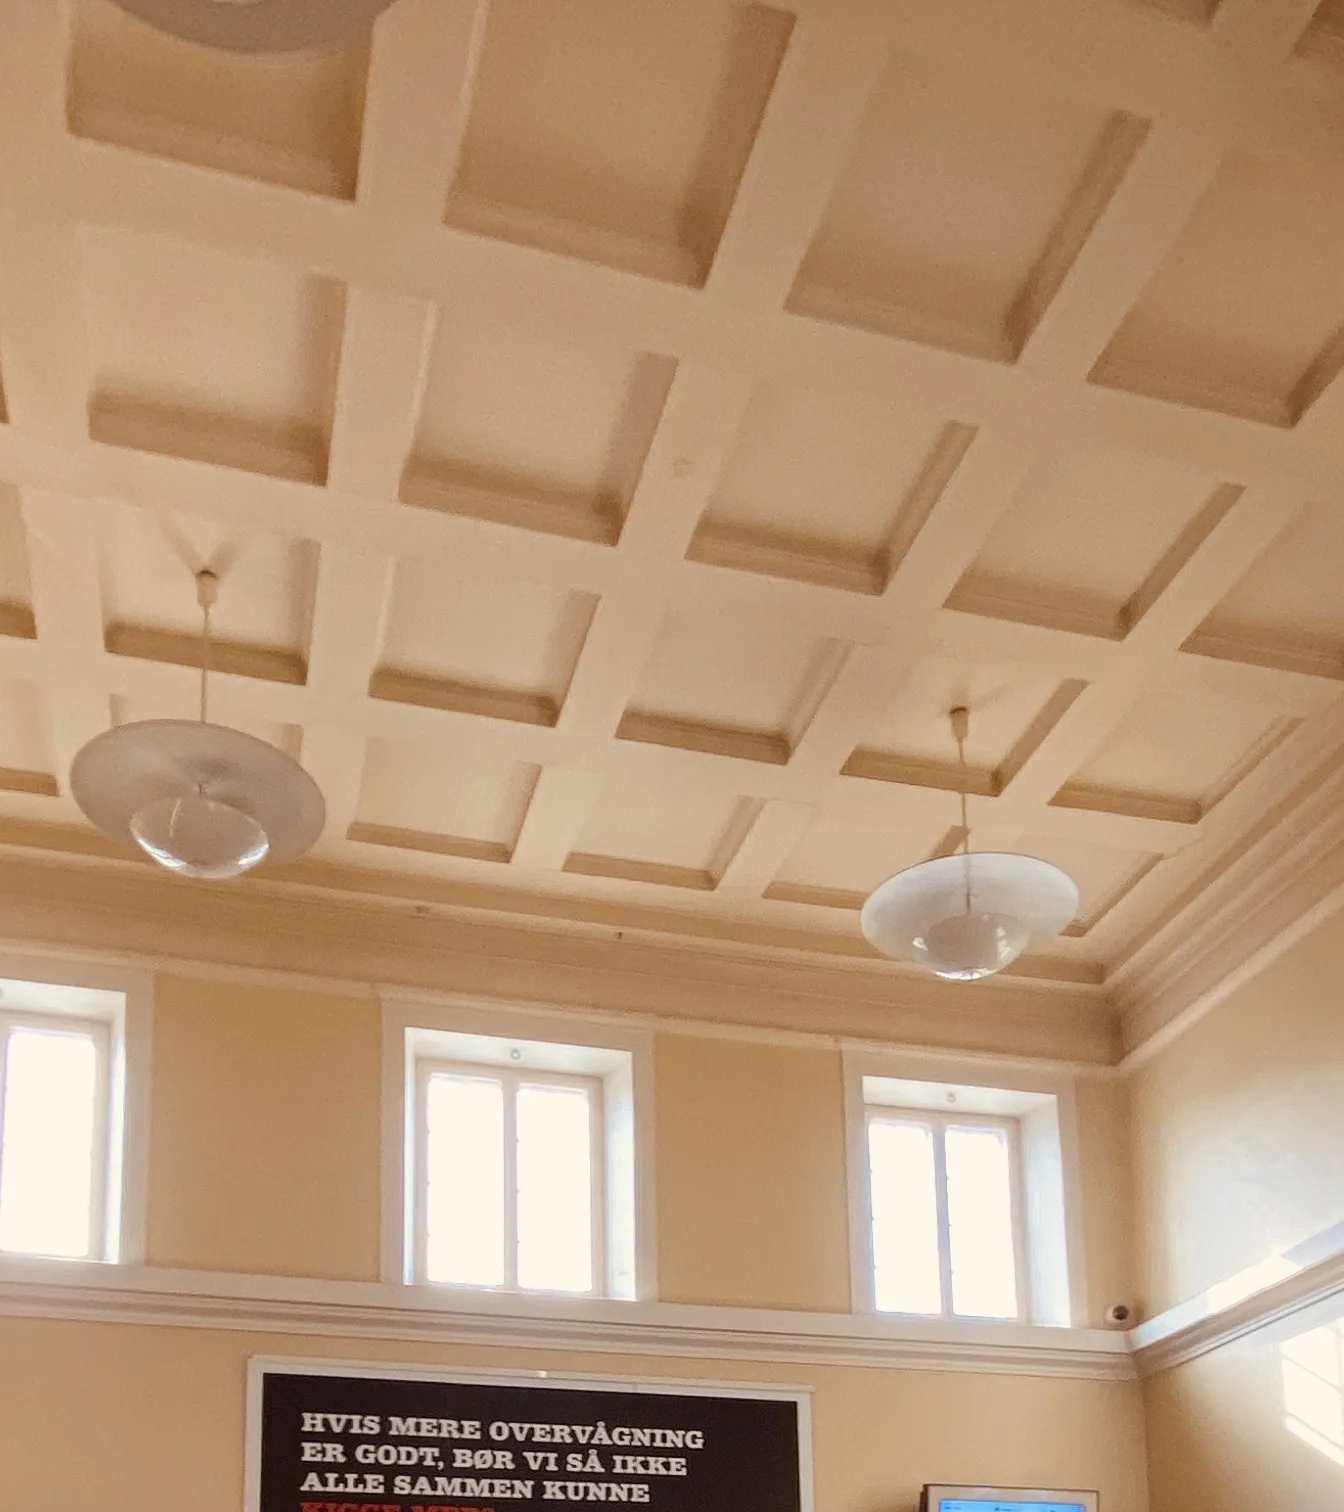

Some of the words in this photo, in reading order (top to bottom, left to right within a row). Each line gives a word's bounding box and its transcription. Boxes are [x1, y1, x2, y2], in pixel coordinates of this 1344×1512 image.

[301, 1412, 381, 1435] HVIS
[388, 1416, 481, 1440] MERE
[488, 1420, 705, 1449] OVERVÅGNING
[301, 1442, 347, 1463] ER
[355, 1444, 445, 1471] GODT,
[452, 1448, 516, 1470] BØR
[522, 1451, 559, 1471] VI
[566, 1449, 606, 1473] SÅ
[612, 1455, 688, 1476] IKKE
[299, 1472, 386, 1494] ALLE
[393, 1475, 535, 1499] SAMMEN
[542, 1480, 651, 1503] KUNNE
